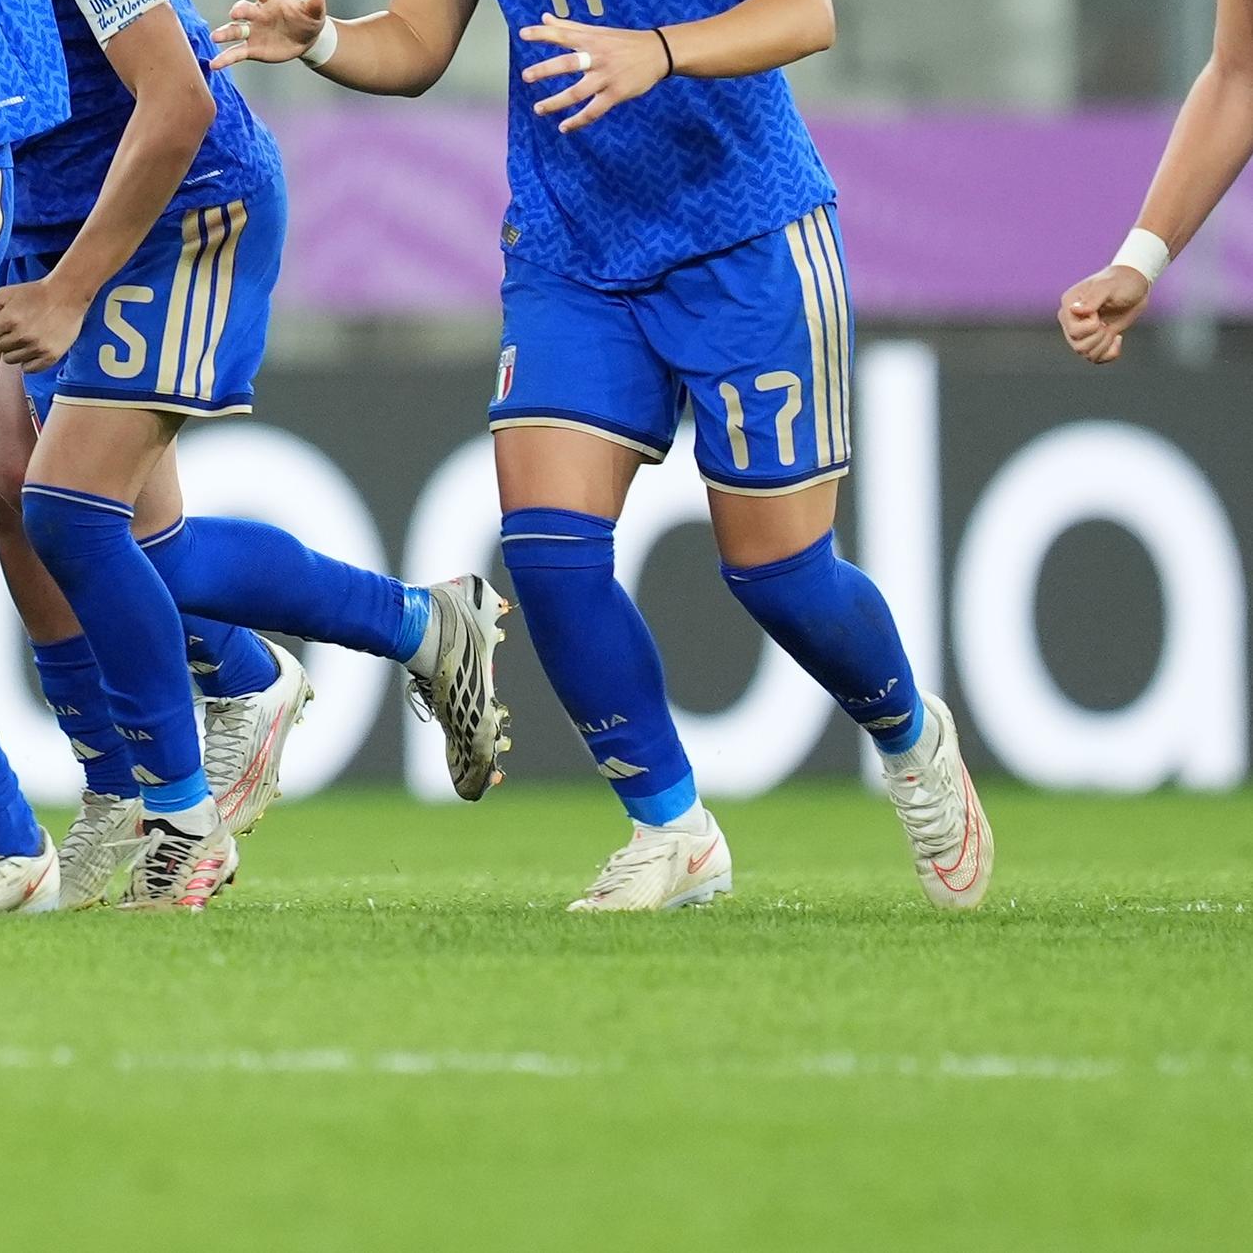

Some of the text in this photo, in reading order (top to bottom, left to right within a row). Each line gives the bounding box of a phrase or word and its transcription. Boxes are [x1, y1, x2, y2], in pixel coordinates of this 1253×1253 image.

[97, 12, 117, 31] the
[98, 285, 155, 379] 5
[718, 370, 803, 471] 17
